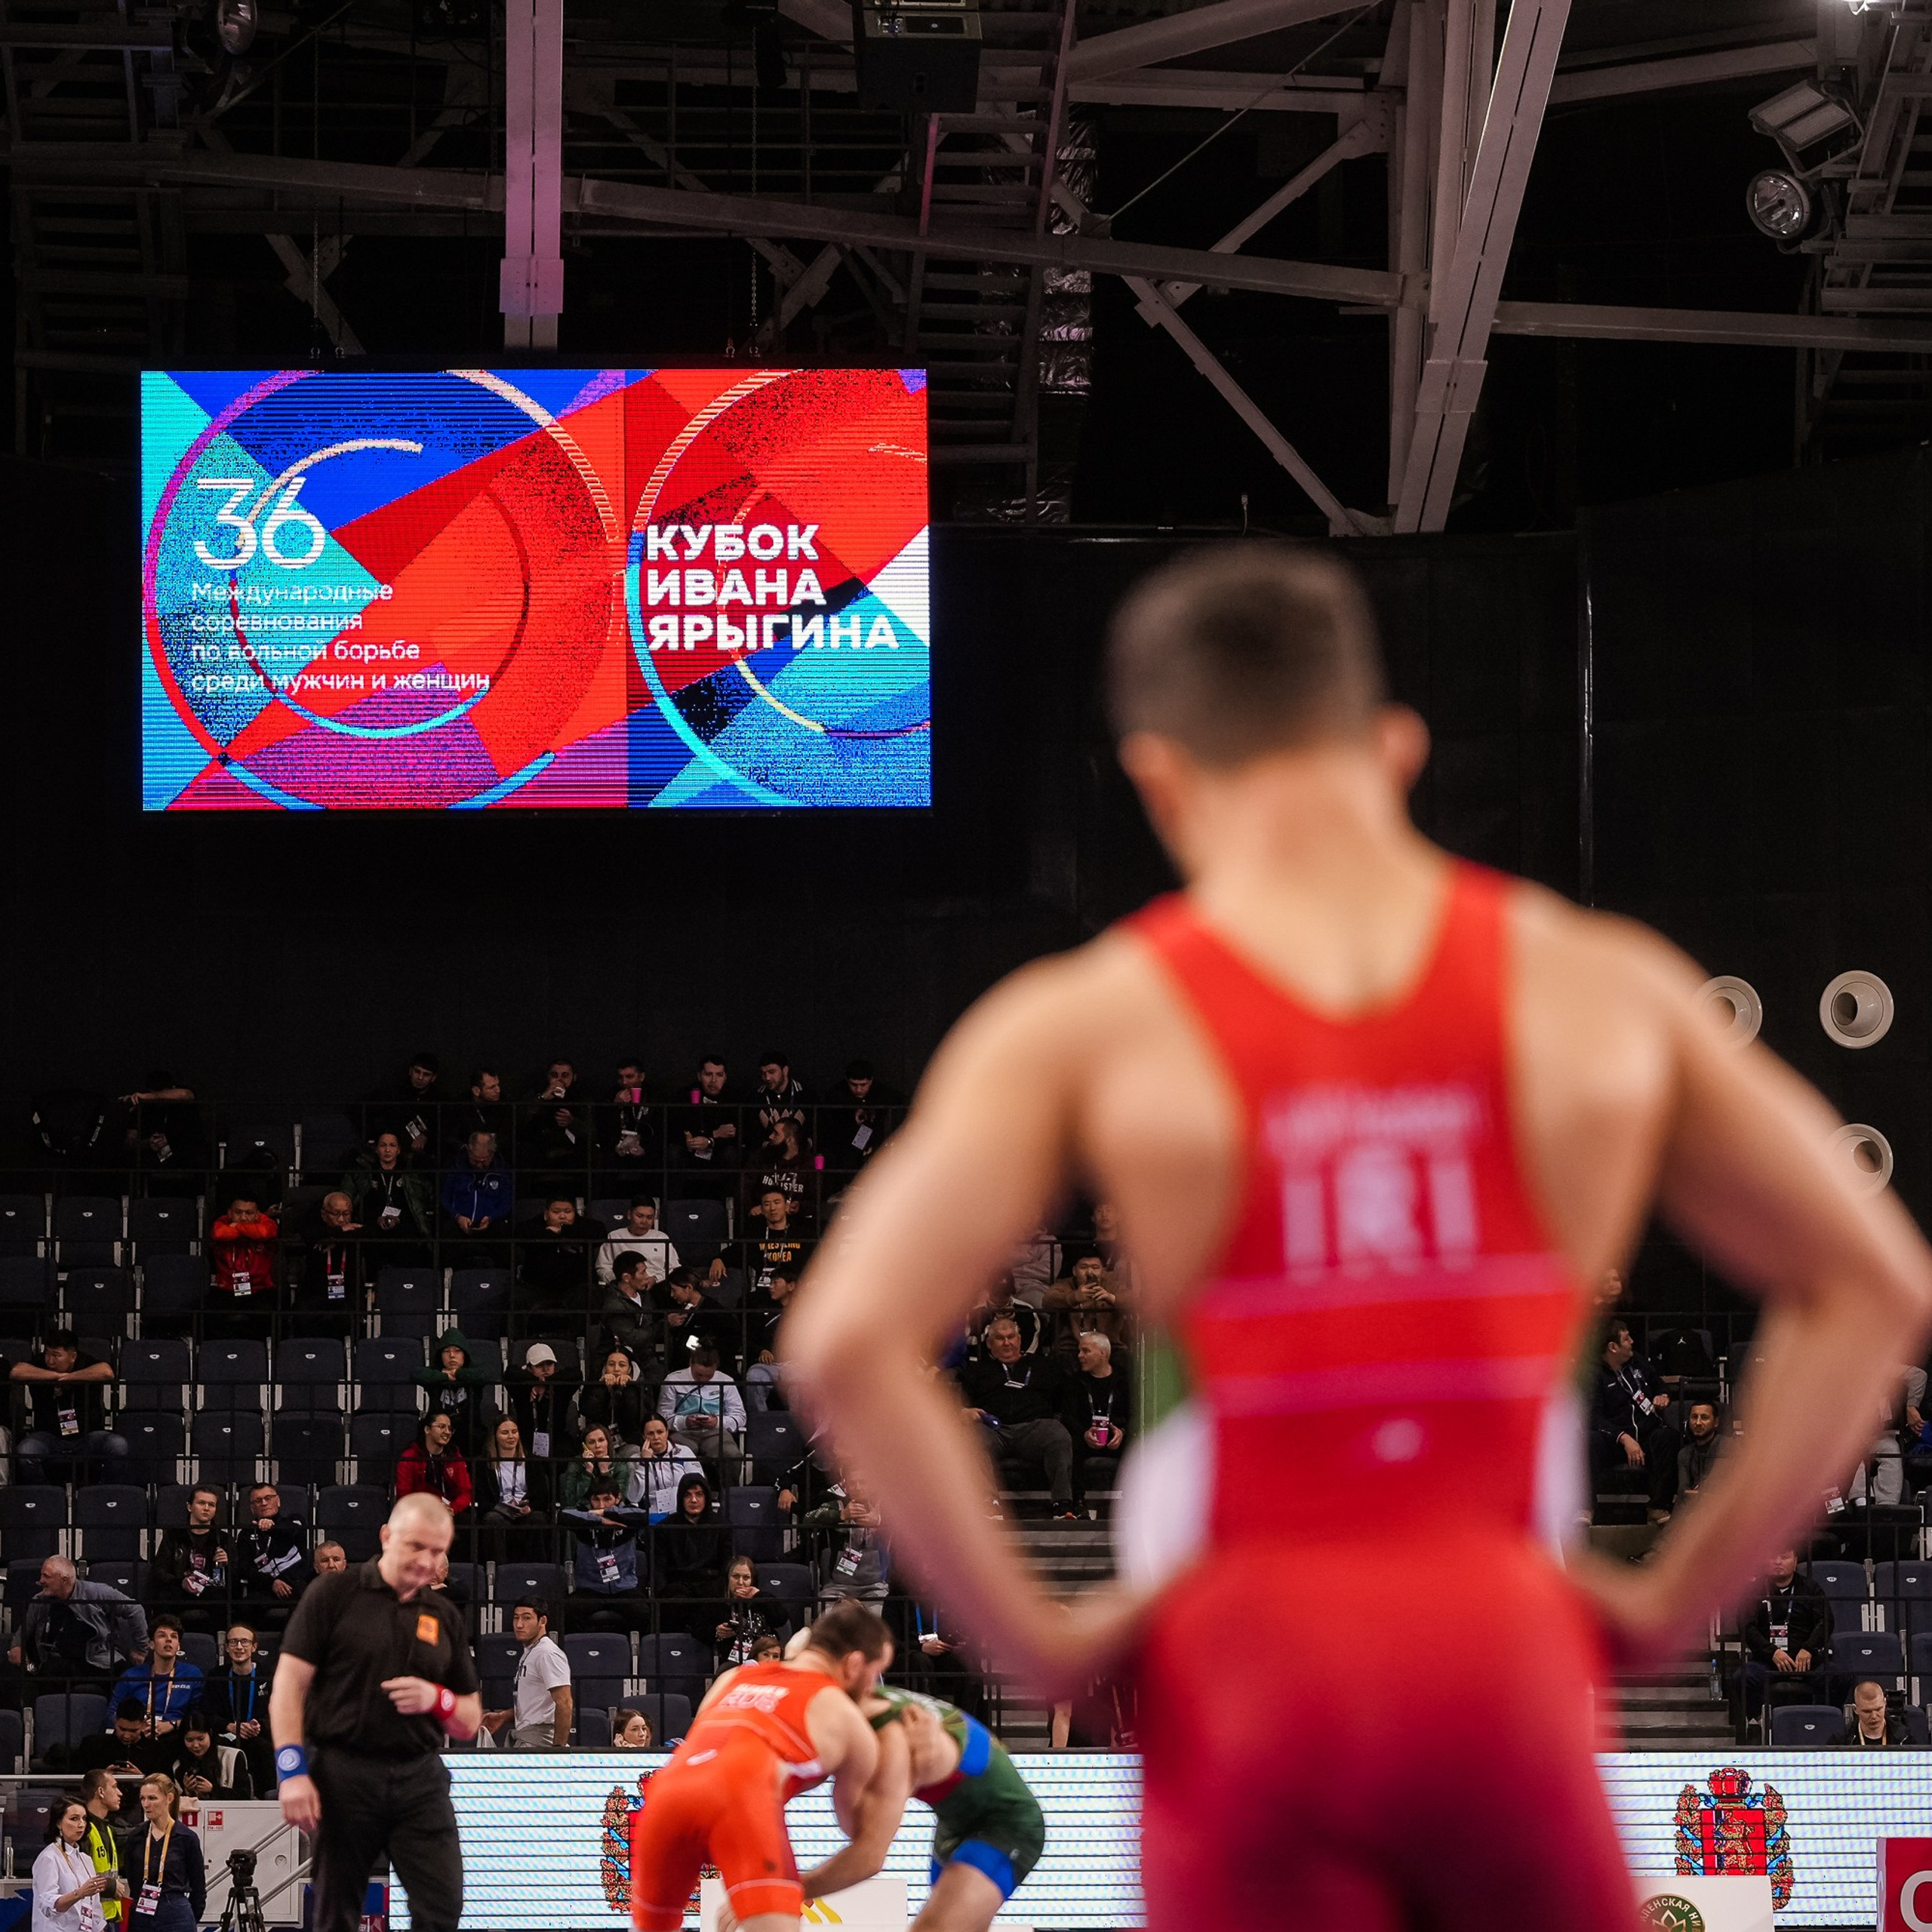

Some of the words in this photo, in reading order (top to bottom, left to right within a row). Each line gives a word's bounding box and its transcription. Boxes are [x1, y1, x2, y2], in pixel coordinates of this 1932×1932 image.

[194, 477, 325, 570] 36
[647, 524, 820, 561] КУБОК
[192, 583, 393, 605] Международные
[648, 568, 827, 606] ИВАНА
[192, 614, 362, 635] соревнования
[648, 614, 900, 650] ЯРЫГИНА
[192, 645, 221, 660] по
[228, 640, 328, 660] вольной
[334, 640, 420, 664] борьбе
[191, 675, 265, 694] среди
[272, 674, 365, 695] мужчин
[371, 674, 386, 688] и
[393, 673, 491, 692] женщин
[96, 1846, 106, 1859] 15
